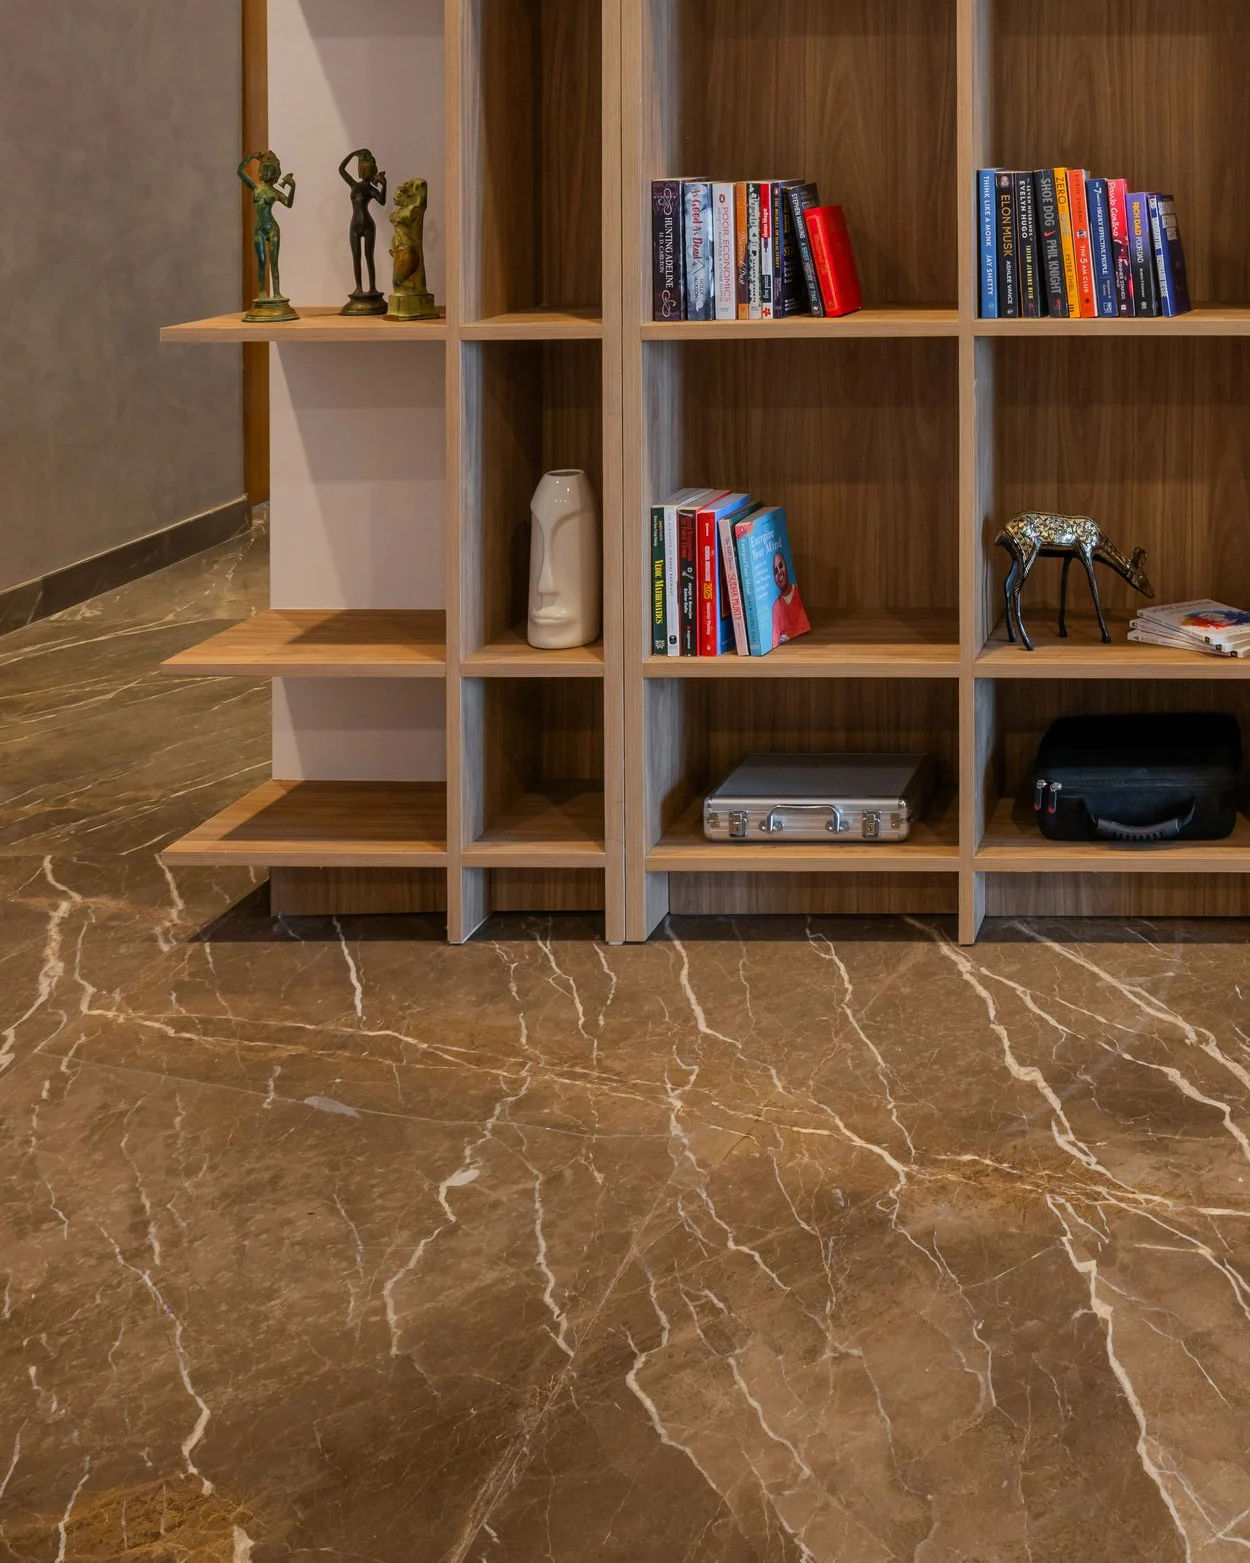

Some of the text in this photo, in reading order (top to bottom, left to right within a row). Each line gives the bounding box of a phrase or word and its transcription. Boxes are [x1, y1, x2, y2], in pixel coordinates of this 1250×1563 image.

[691, 200, 703, 260] Good Dead
[791, 193, 801, 216] STEPHEN
[1001, 194, 1013, 257] ELON MUSK
[1019, 180, 1028, 239] EVELYN HUGO
[1040, 178, 1054, 227] SHOE DOG
[1056, 177, 1070, 236] ZERO ONE
[664, 217, 674, 289] HUNTING ADELINE
[1132, 201, 1144, 263] RICH DAD POOR DAD
[722, 239, 731, 303] ECONOMICS
[1046, 239, 1061, 294] PHIL KNIGHT
[1082, 265, 1087, 275] AM
[654, 559, 664, 578] VEDIC
[703, 582, 713, 600] 2025
[727, 573, 742, 621] SUDHA MURTY
